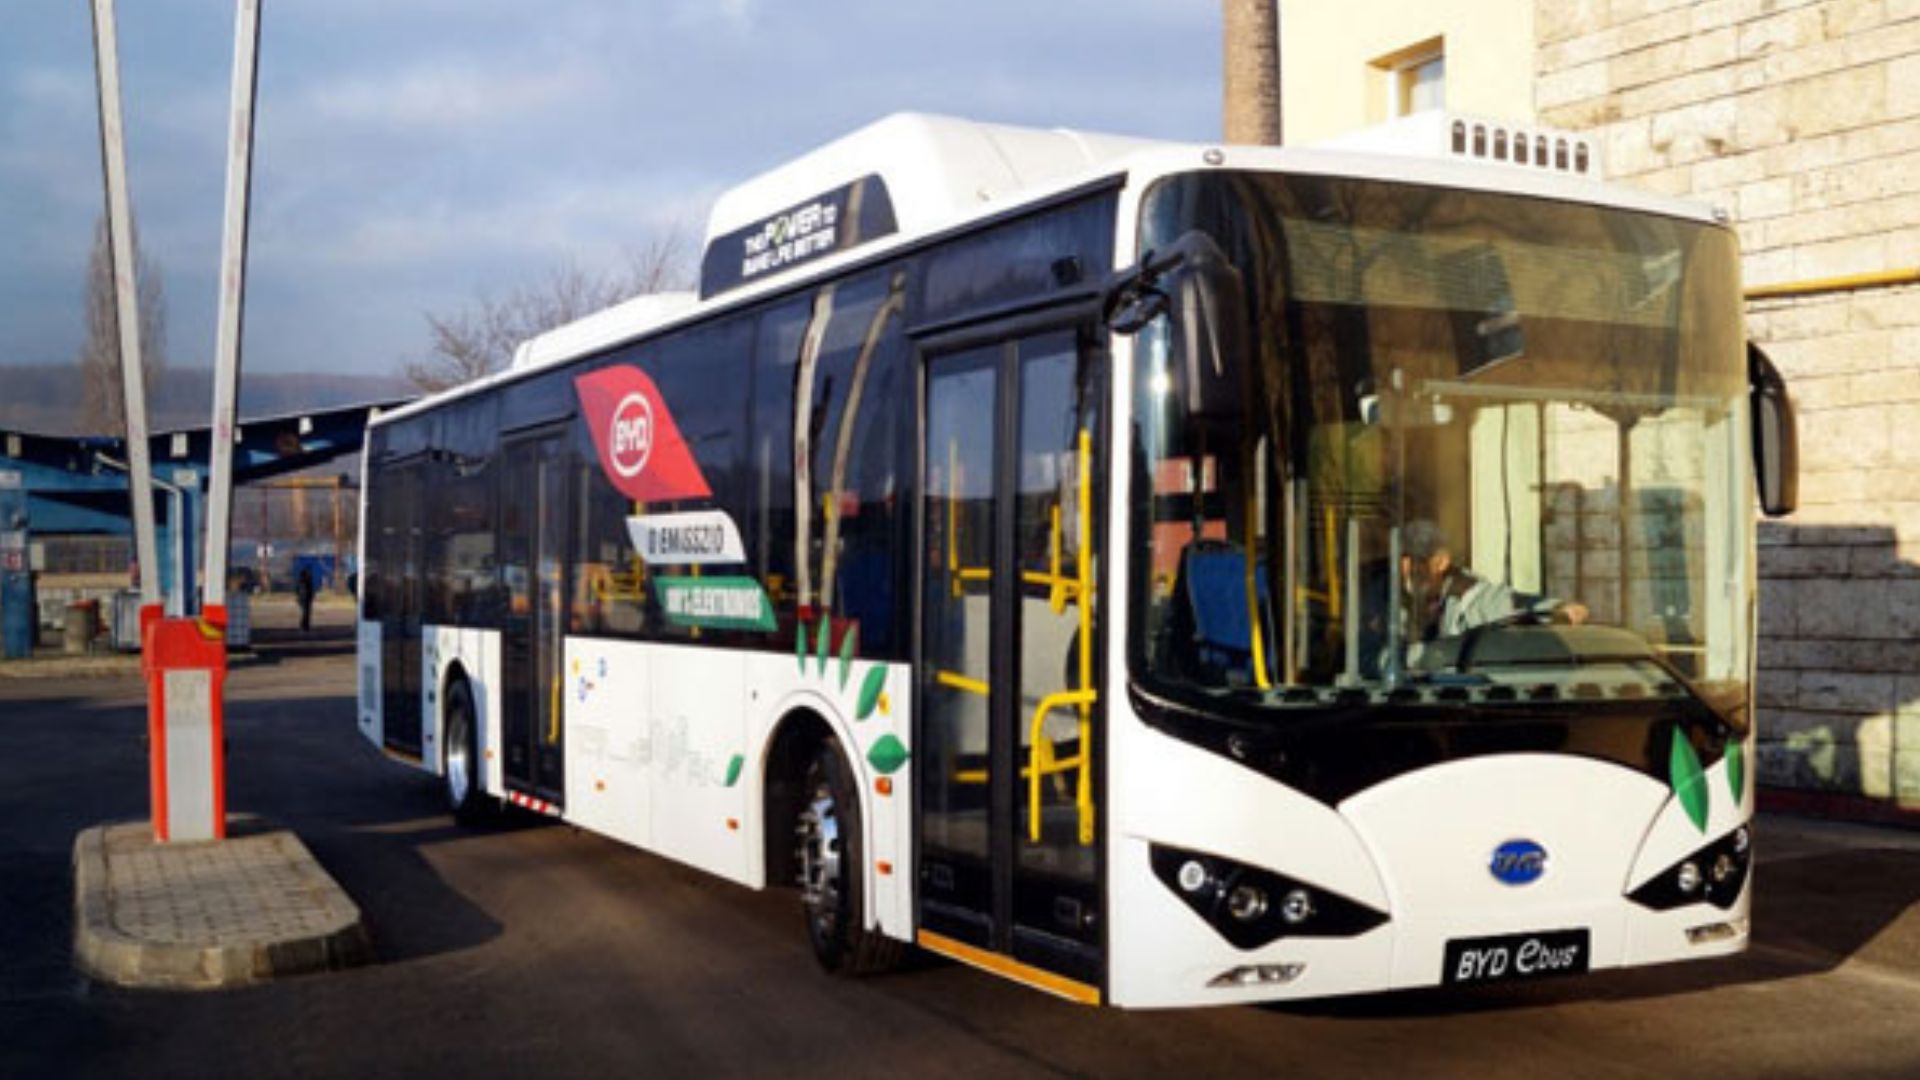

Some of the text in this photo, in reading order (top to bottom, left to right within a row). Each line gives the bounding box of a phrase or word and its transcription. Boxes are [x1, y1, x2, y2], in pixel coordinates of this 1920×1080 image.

[764, 203, 821, 246] POWER
[616, 417, 648, 453] BYD
[1456, 938, 1578, 980] BYD ebus
